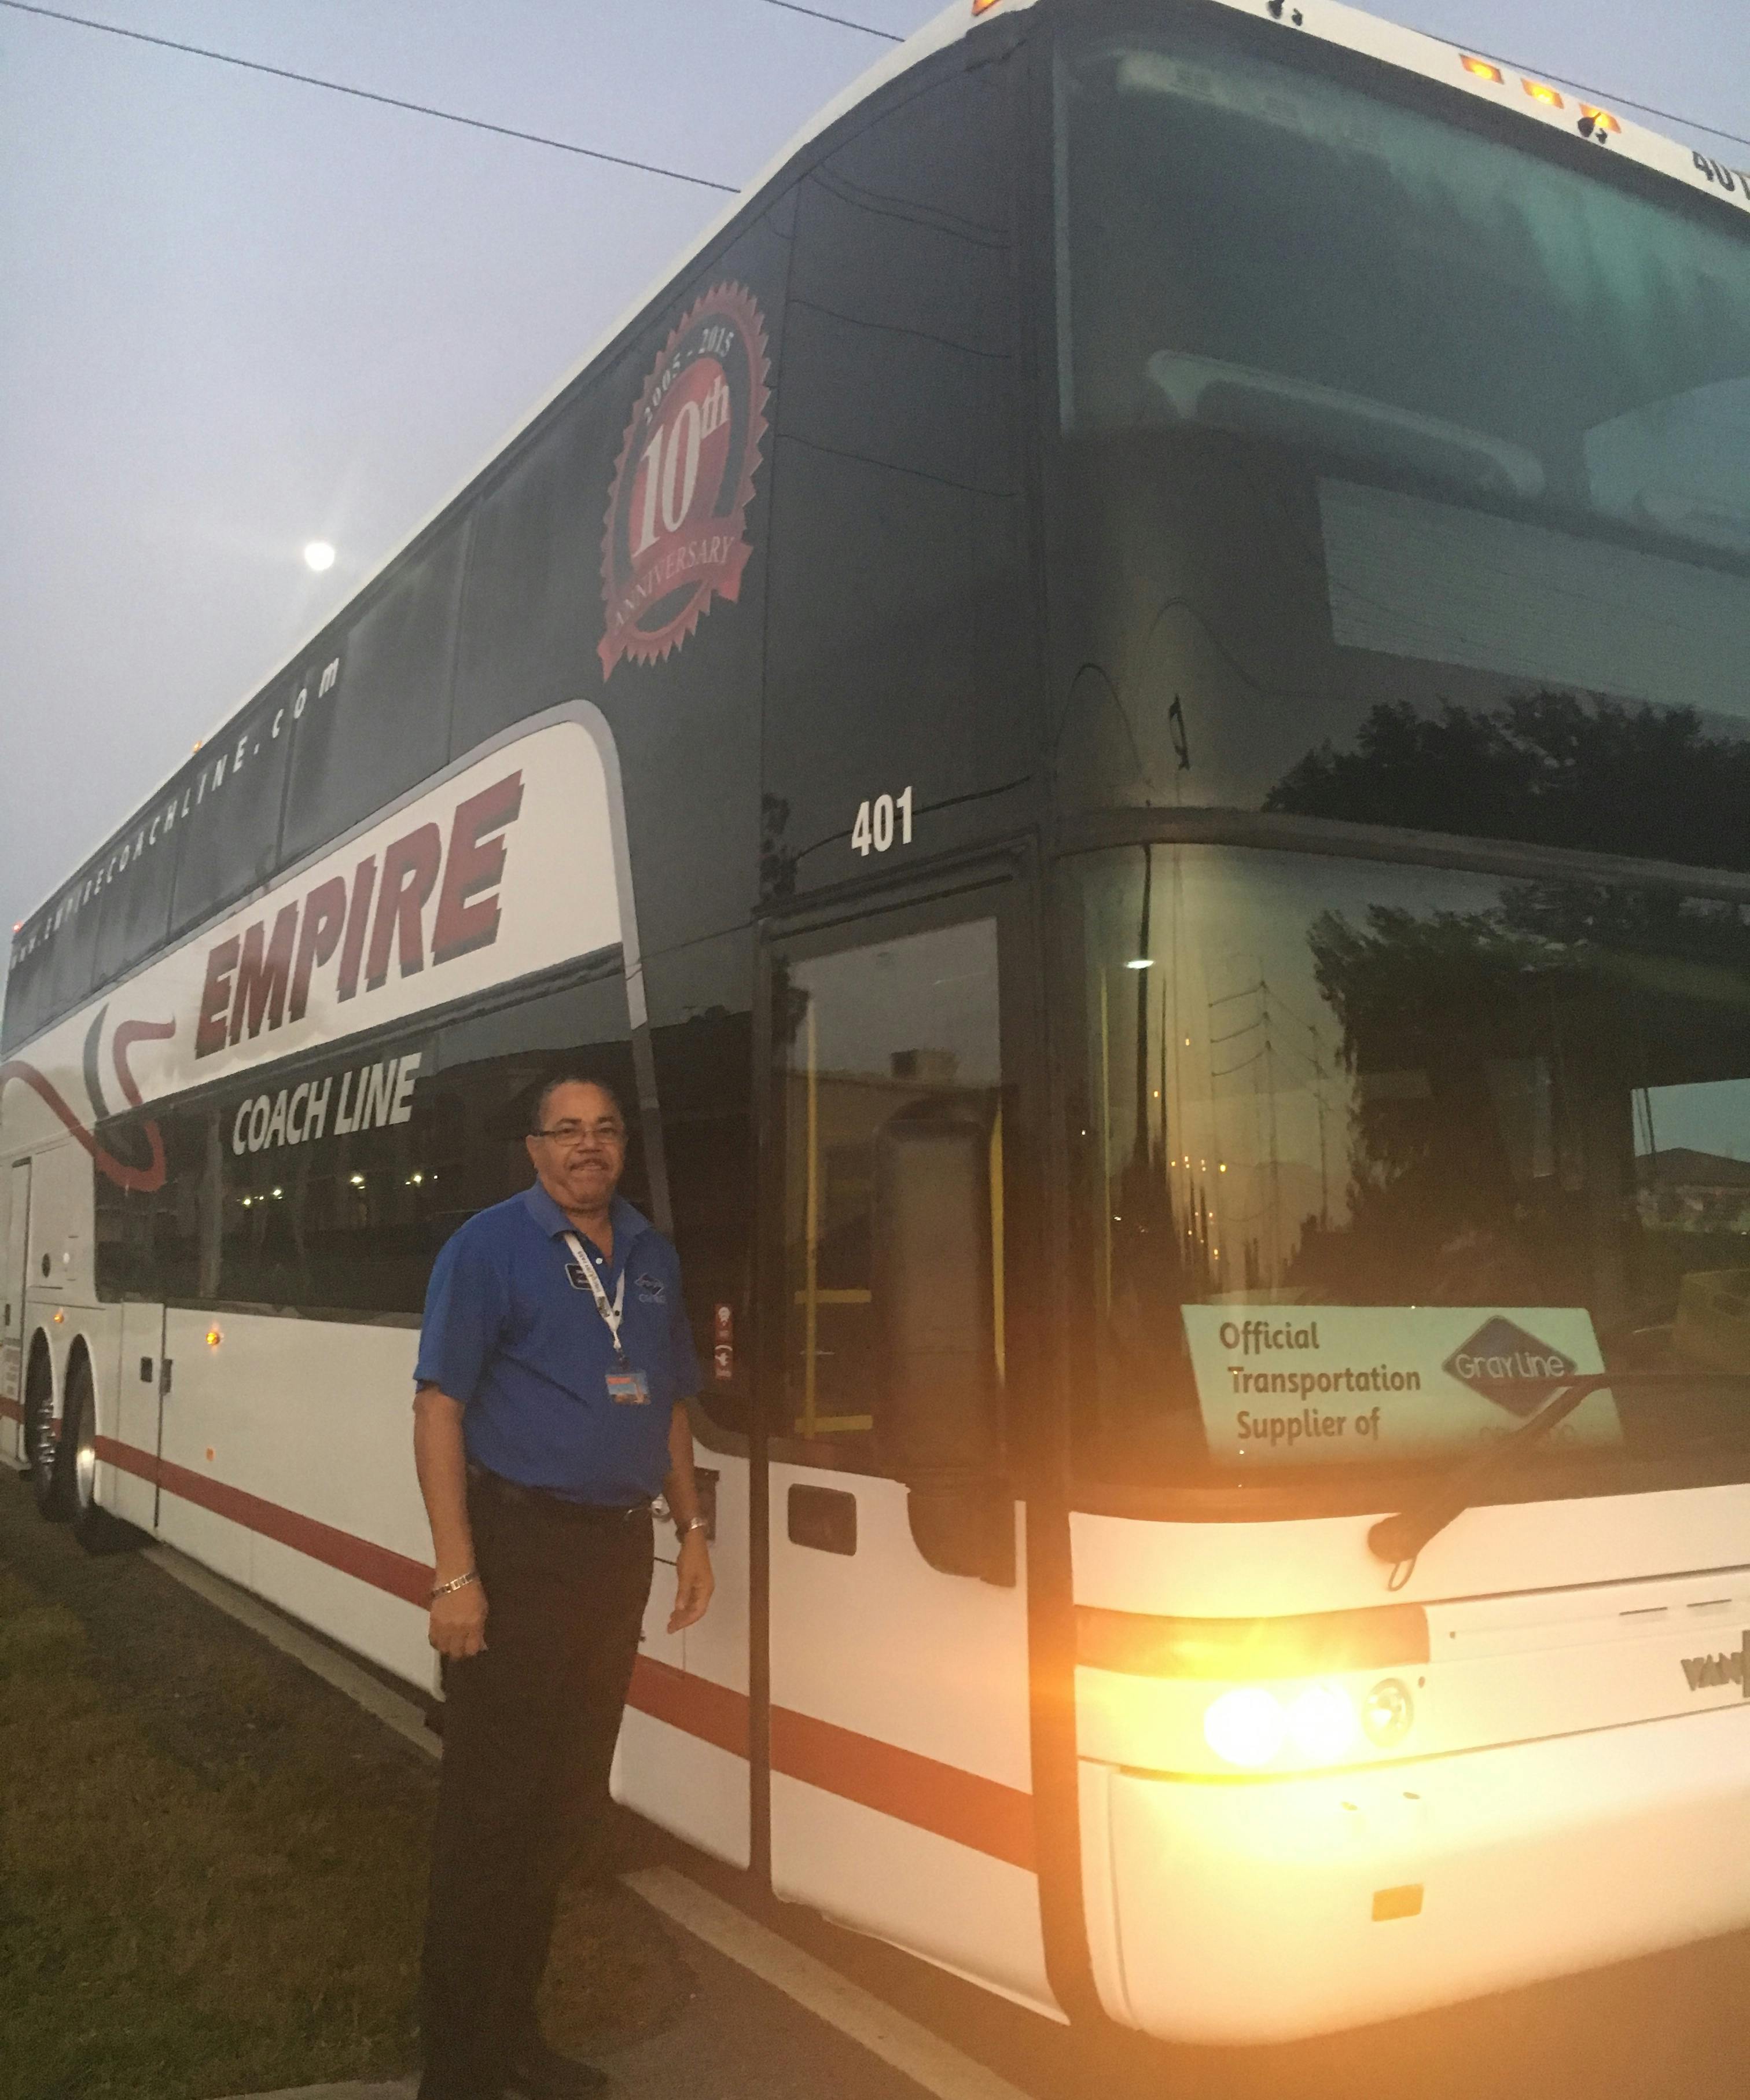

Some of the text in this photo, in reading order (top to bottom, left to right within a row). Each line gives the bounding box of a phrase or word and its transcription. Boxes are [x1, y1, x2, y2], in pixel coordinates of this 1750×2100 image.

[698, 325, 734, 357] 2015
[851, 786, 912, 857] 401
[195, 768, 525, 1060] EMPIRE
[233, 1052, 422, 1156] COACH LINE
[1219, 1320, 1320, 1355] Official
[1227, 1363, 1421, 1401] Transportation
[1237, 1406, 1381, 1446] Supplier of
